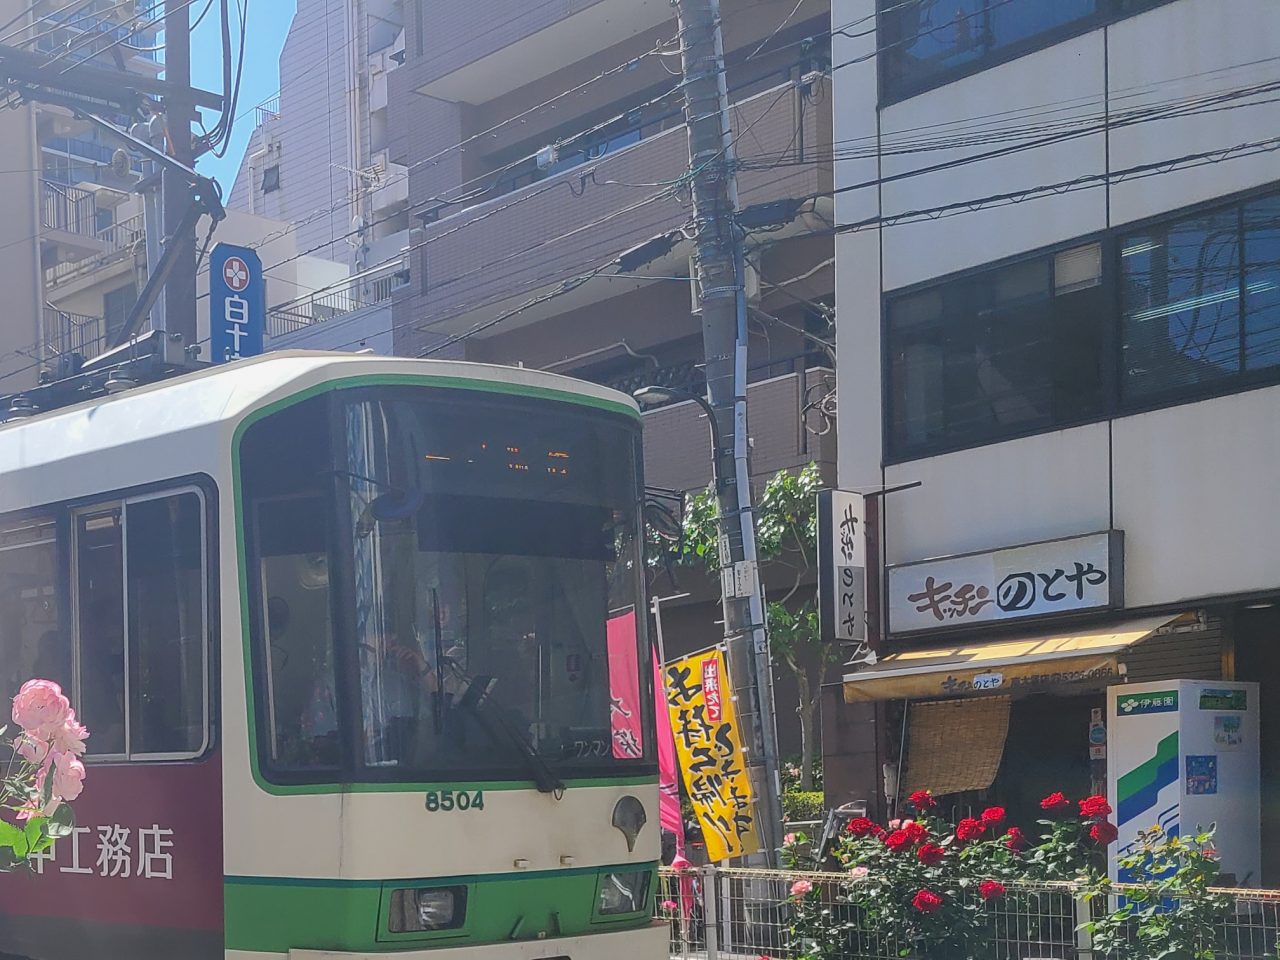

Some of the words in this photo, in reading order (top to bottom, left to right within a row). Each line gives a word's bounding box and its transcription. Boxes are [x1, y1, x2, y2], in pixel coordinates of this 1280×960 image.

[224, 294, 249, 360] 白十
[1138, 696, 1174, 709] 伊藤園
[425, 790, 485, 812] 8504
